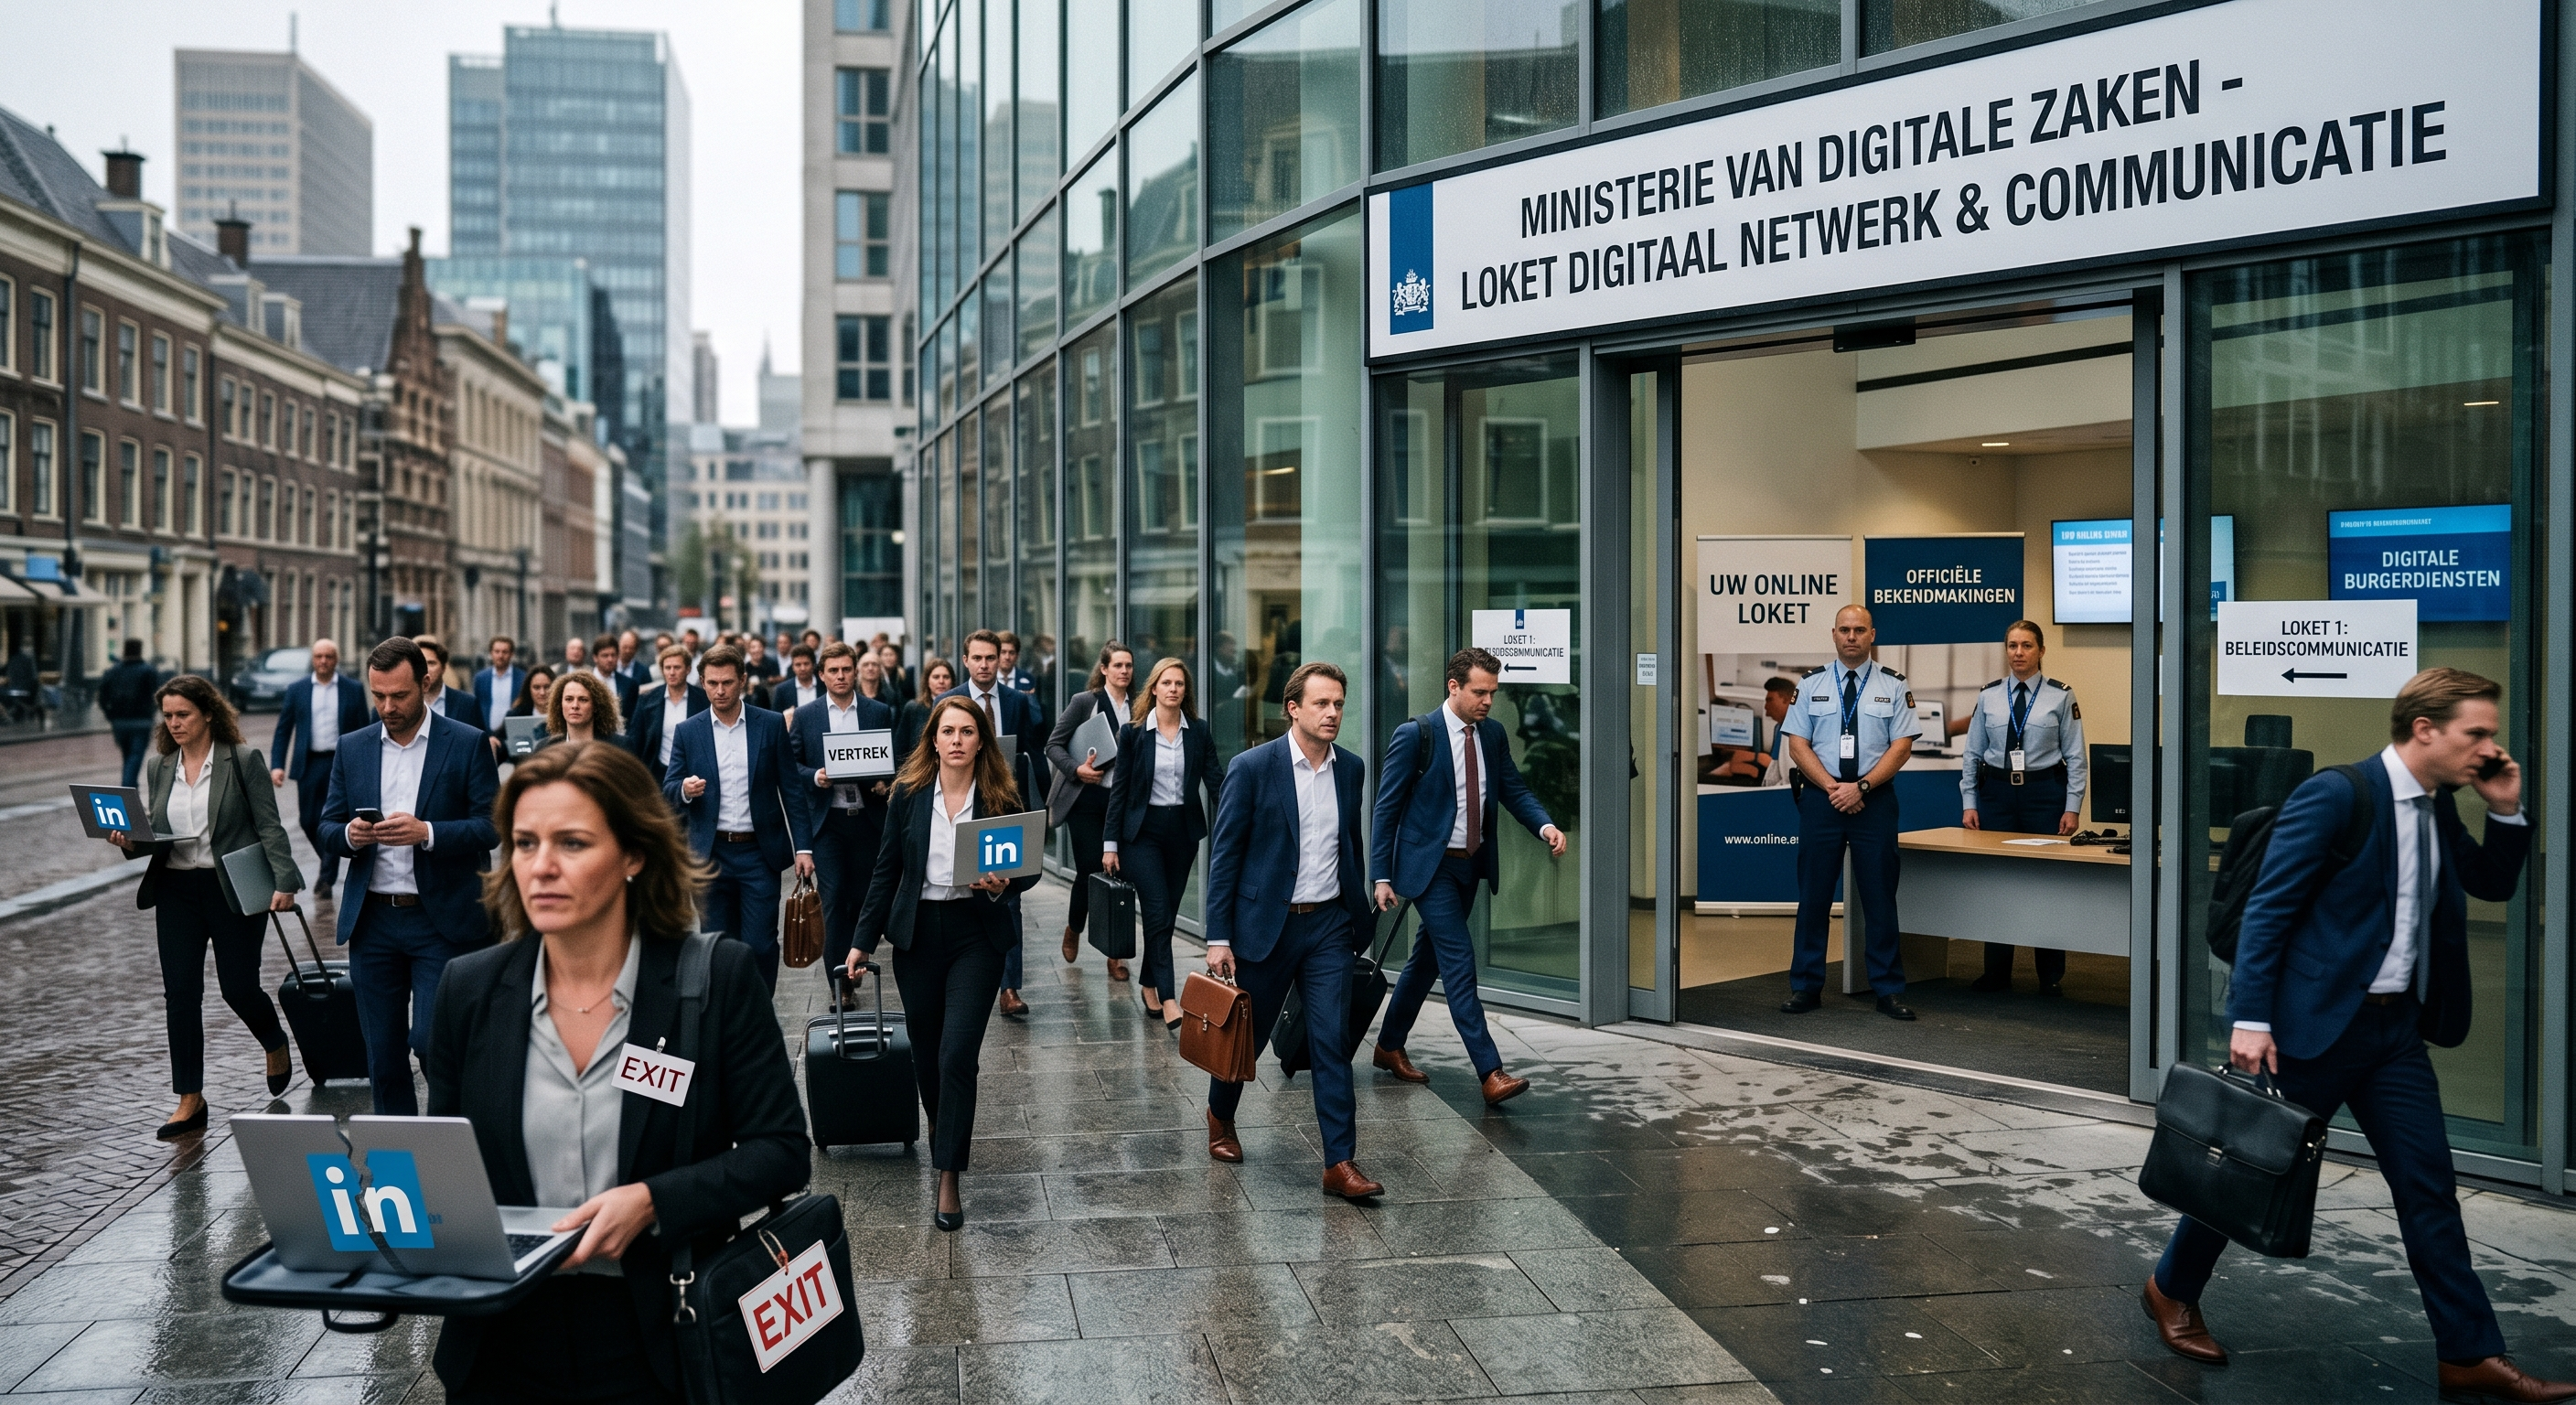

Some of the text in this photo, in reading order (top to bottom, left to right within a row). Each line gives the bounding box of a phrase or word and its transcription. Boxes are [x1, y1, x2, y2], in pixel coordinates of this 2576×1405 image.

[1521, 59, 2243, 238] MINISTERIE VAN DIGITALE ZAKEN -
[1462, 101, 2447, 310] LOKET DIGITAAL NETWERK & COMMUNICATIE
[2382, 549, 2459, 567] DIGITALE
[1710, 574, 1838, 595] UW ONLINE
[1906, 564, 1981, 585] OFFICIËLE
[2345, 570, 2500, 589] BURGERDIENSTEN
[1873, 588, 2015, 604] BEKENDMAKINGEN
[1738, 602, 1810, 625] LOKET
[2281, 620, 2348, 636] LOKET 1:
[2225, 641, 2409, 657] BELEIDSCOMMUNICATIE
[828, 745, 889, 762] VERTREK
[94, 798, 125, 826] in
[984, 834, 1017, 865] in
[621, 1056, 686, 1091] EXIT
[326, 1166, 417, 1235] in
[754, 1261, 828, 1351] EXIT
